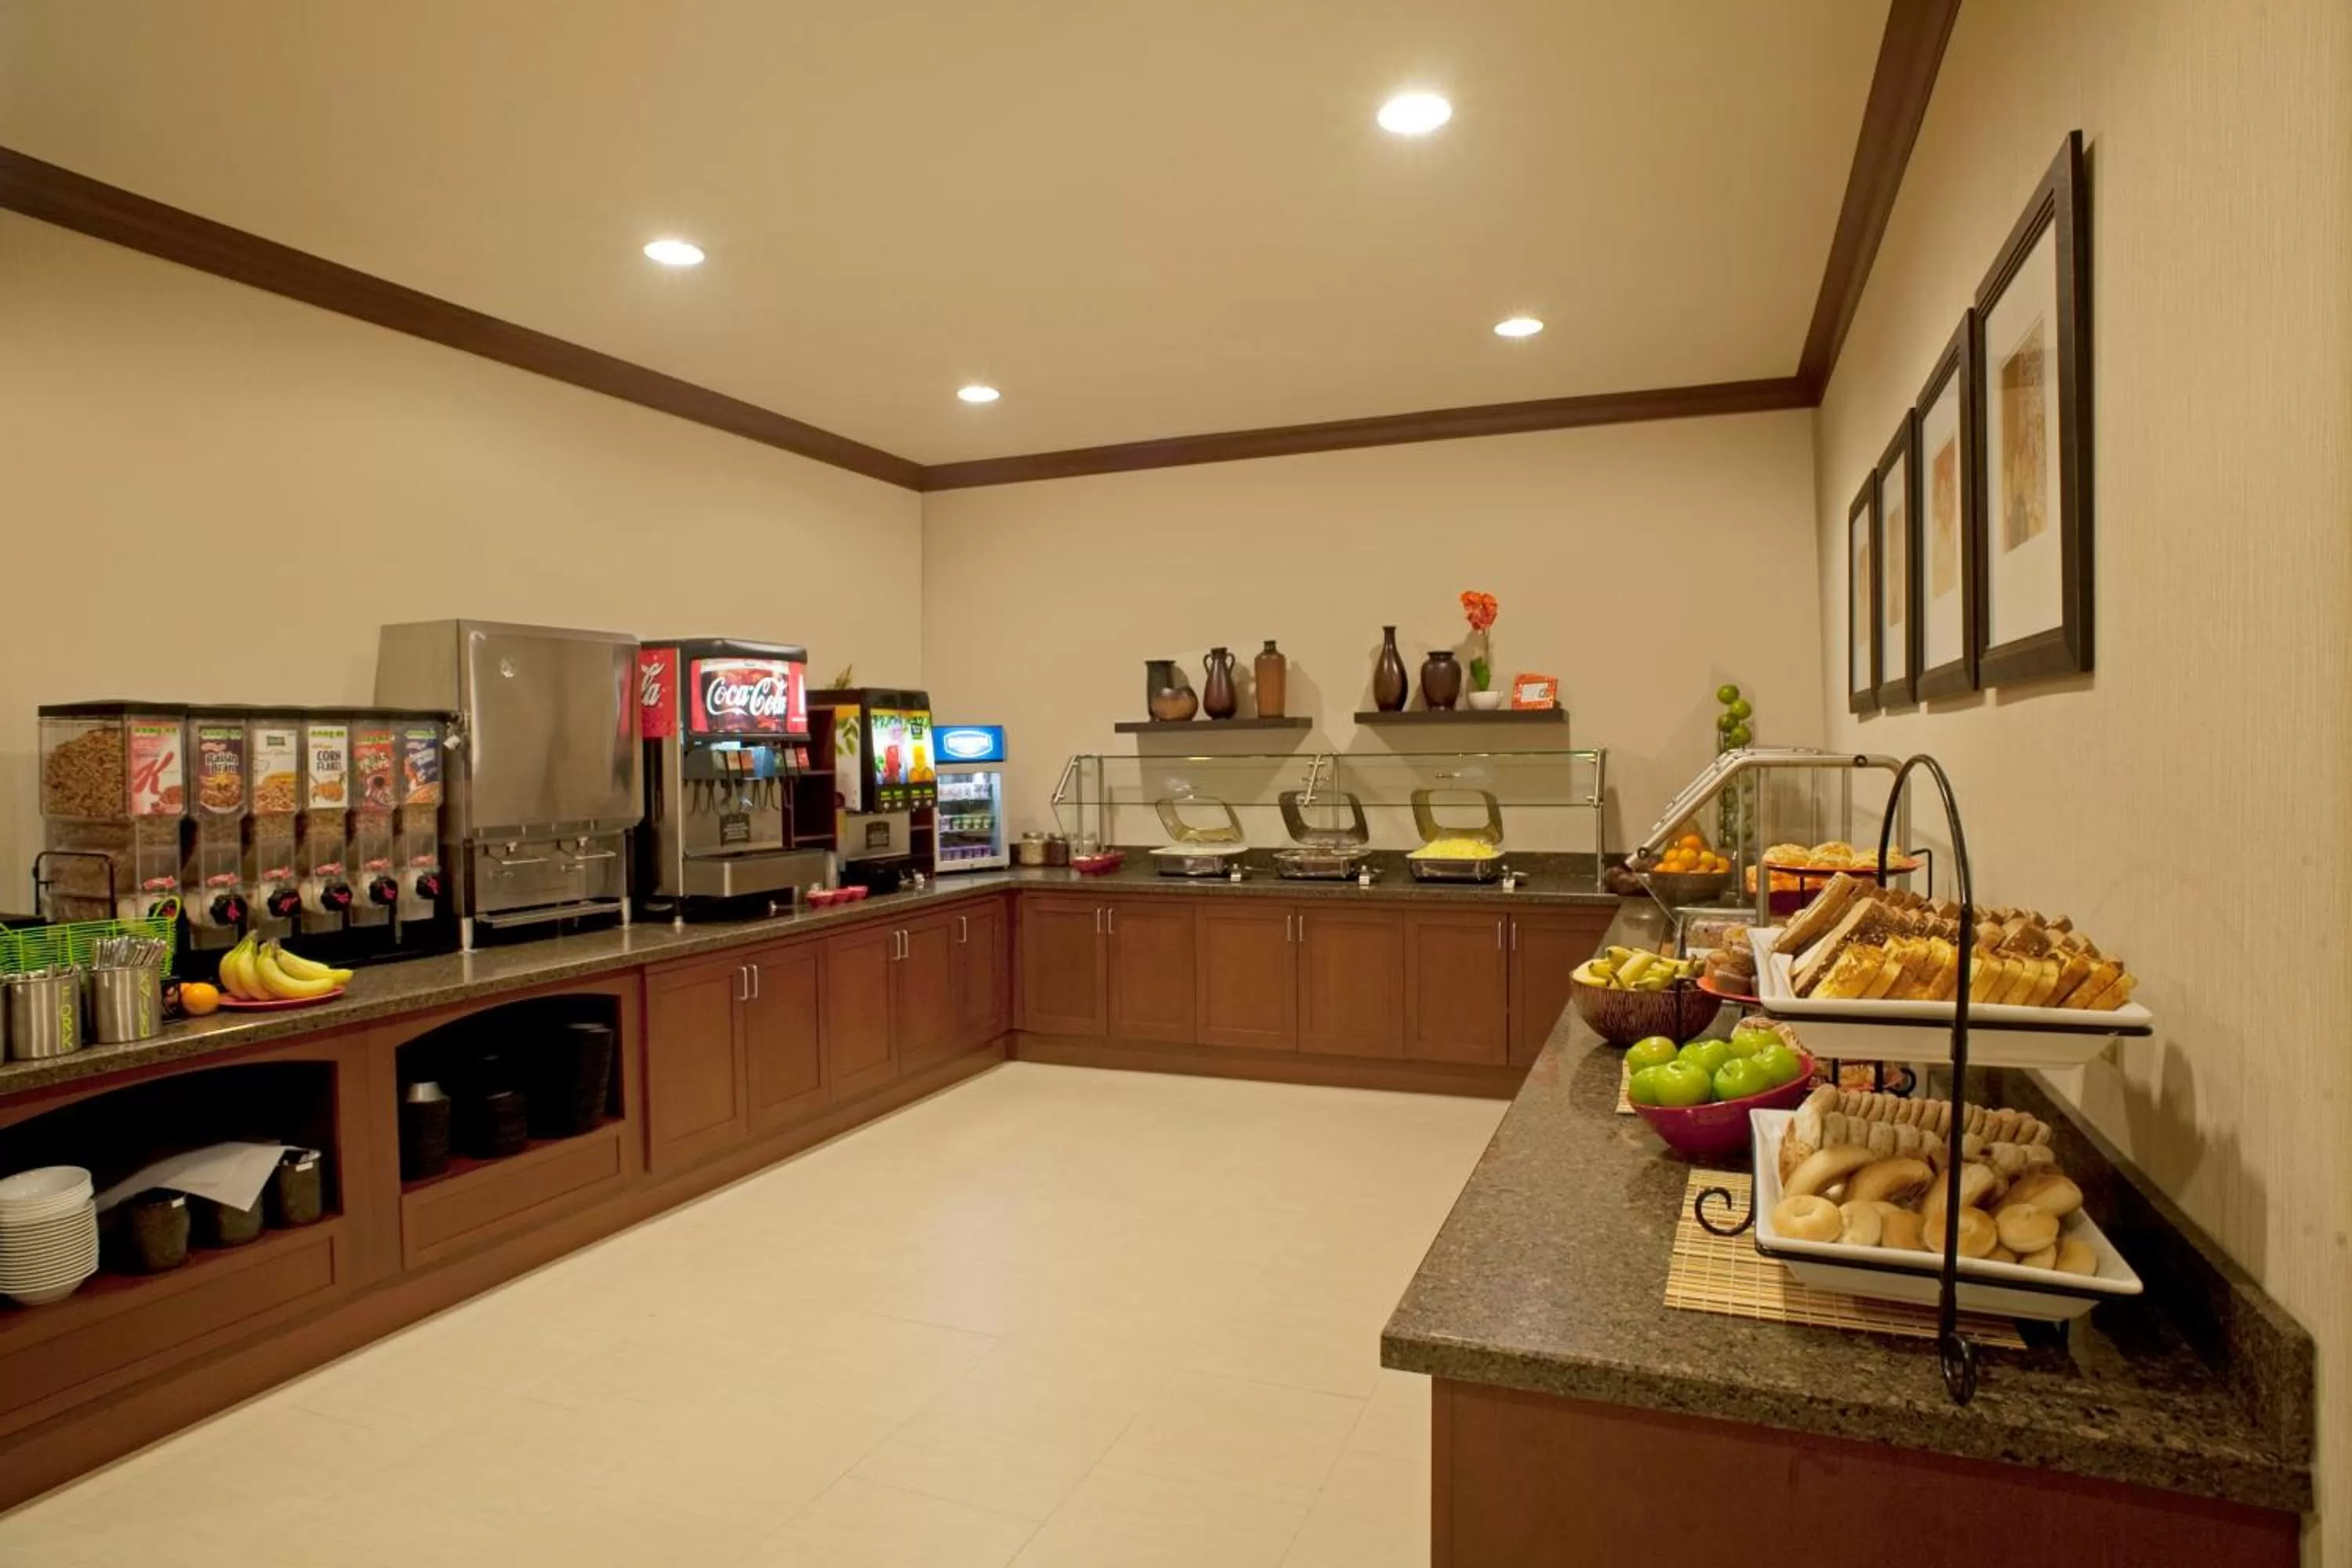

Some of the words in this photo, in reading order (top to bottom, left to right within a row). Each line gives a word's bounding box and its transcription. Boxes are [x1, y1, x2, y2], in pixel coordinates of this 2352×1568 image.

[706, 677, 787, 716] Coca-Cola
[317, 750, 341, 760] CORN
[60, 985, 73, 1049] FORK
